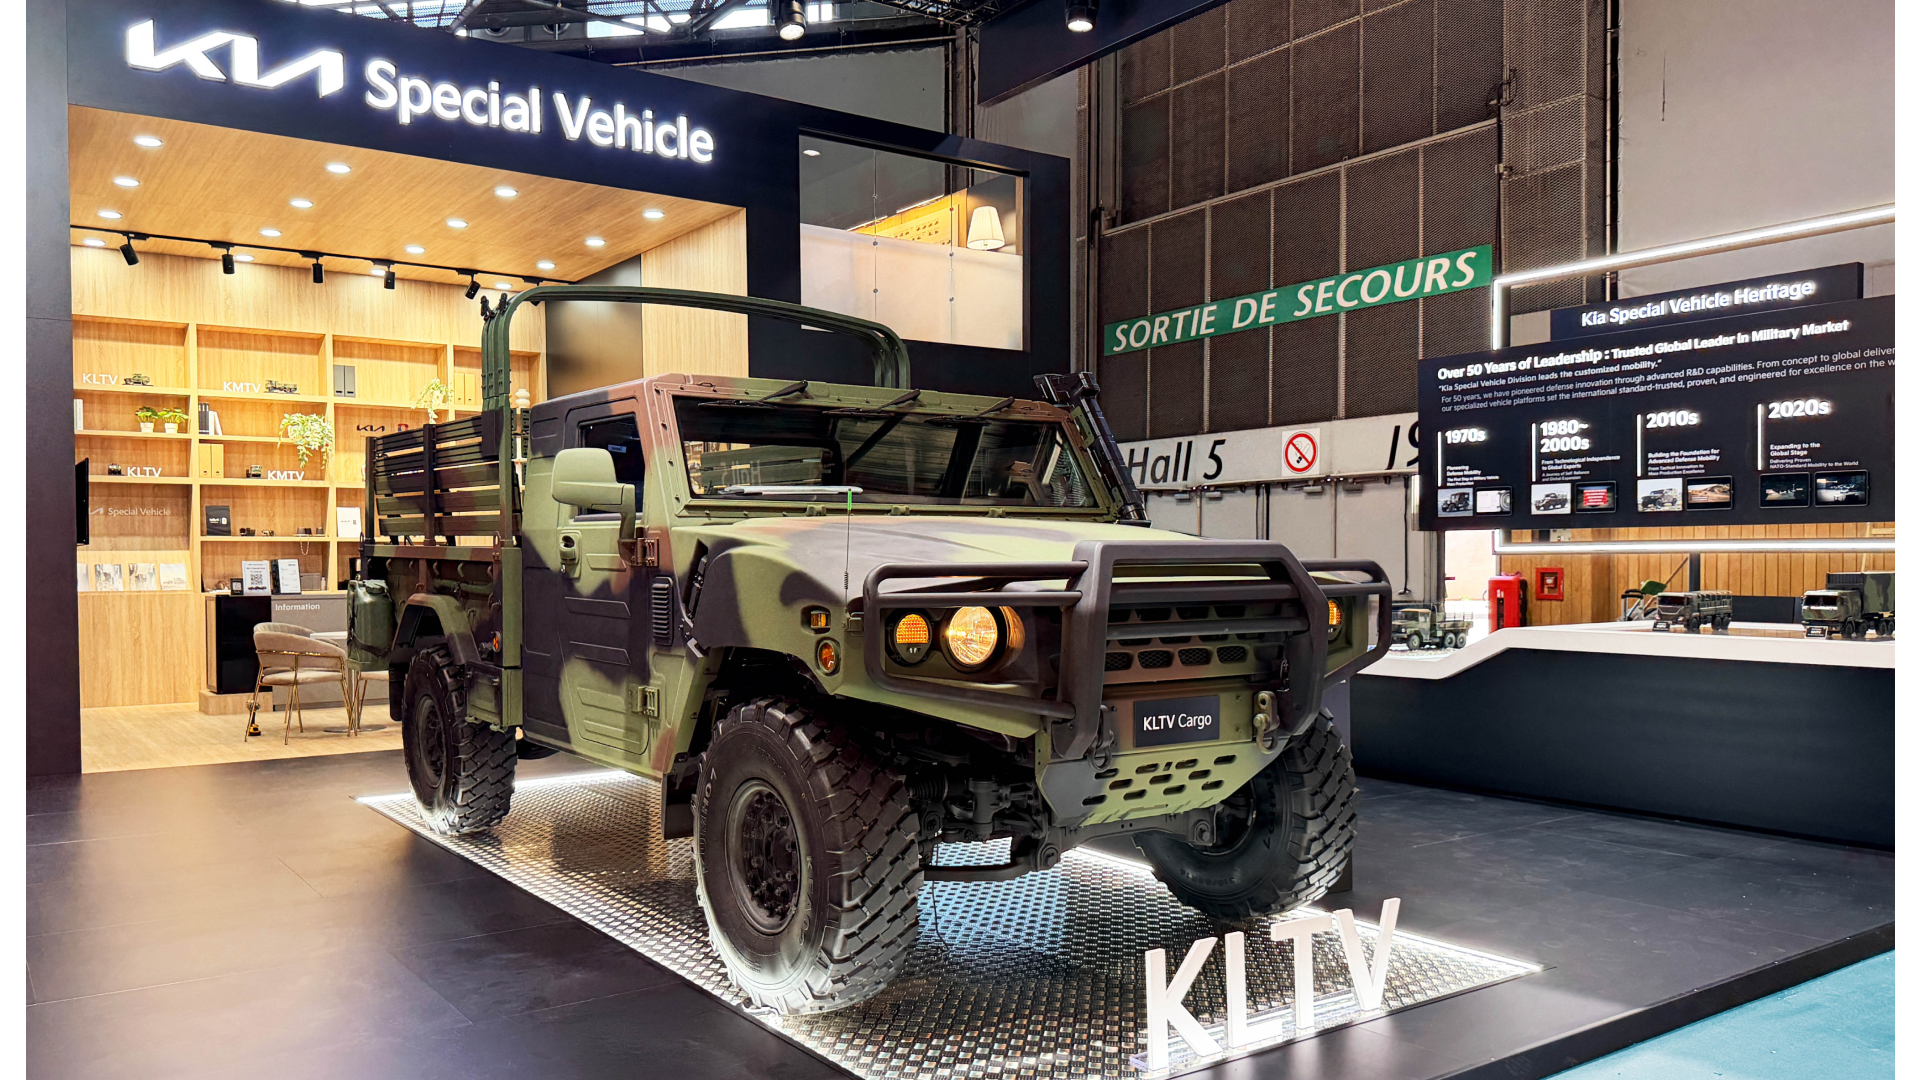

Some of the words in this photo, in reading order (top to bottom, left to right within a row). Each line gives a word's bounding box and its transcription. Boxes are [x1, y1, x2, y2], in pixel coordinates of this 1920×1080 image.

[365, 59, 542, 134] Special
[553, 92, 715, 163] Vehicle
[1112, 304, 1218, 352] SORTIE
[1232, 291, 1278, 329] DE
[1293, 251, 1478, 317] SECOURS
[1582, 312, 1606, 327] Kia
[1609, 302, 1665, 325] Special
[1669, 293, 1730, 314] Vehicle
[1733, 280, 1814, 303] Heritage
[1438, 368, 1465, 380] Over
[1467, 364, 1483, 376] 50
[1484, 361, 1516, 375] Years
[1518, 357, 1532, 370] of
[1534, 348, 1602, 369] Leadership
[1611, 342, 1653, 359] Trusted
[1654, 338, 1692, 354] Global
[1694, 334, 1735, 349] Leader
[1737, 332, 1748, 344] in
[1751, 327, 1800, 343] Military
[1802, 320, 1850, 336] Market
[82, 373, 118, 385] KLTV
[1454, 381, 1478, 392] Special
[1480, 378, 1506, 388] Vehicle
[1508, 374, 1536, 385] Division
[1538, 371, 1558, 381] leads
[1560, 370, 1573, 378] the
[1574, 364, 1620, 376] customized
[1454, 401, 1488, 412] specialized
[1489, 398, 1512, 408] vehicle
[1514, 395, 1546, 406] platforms
[1558, 392, 1570, 400] the
[1572, 386, 1617, 398] international
[1618, 380, 1685, 394] standard-trusted,
[1687, 378, 1718, 388] proven,
[1720, 374, 1736, 384] and
[1738, 369, 1786, 382] engineered
[1789, 366, 1802, 376] for
[1804, 362, 1852, 375] excellence
[1854, 361, 1867, 369] on
[1869, 358, 1886, 368] the
[1463, 393, 1482, 403] years,
[1494, 389, 1510, 398] have
[1511, 385, 1545, 397] pioneered
[1546, 382, 1574, 393] defense
[1575, 379, 1613, 390] innovation
[1615, 374, 1645, 386] through
[1646, 370, 1685, 381] advanced
[1686, 367, 1704, 376] R&D
[1706, 363, 1755, 376] capabilities.
[1757, 360, 1780, 369] From
[1782, 355, 1818, 366] concept
[1820, 354, 1830, 362] to
[1832, 350, 1861, 362] global
[223, 381, 261, 393] KMTV
[1768, 399, 1830, 418] 2020s
[1540, 420, 1588, 436] 1980~
[1646, 411, 1698, 428] 2010s
[1444, 428, 1486, 444] 1970s
[1540, 436, 1590, 453] 2000s
[1127, 440, 1193, 485] Hall
[1203, 438, 1226, 480] 5
[127, 466, 162, 478] KLTV
[268, 470, 304, 481] KMTV
[108, 507, 138, 517] Special
[140, 508, 171, 516] Vehicle
[275, 602, 320, 611] Information
[1143, 714, 1176, 731] KLTV
[1178, 714, 1212, 730] Cargo
[1145, 897, 1401, 1071] KLTV
